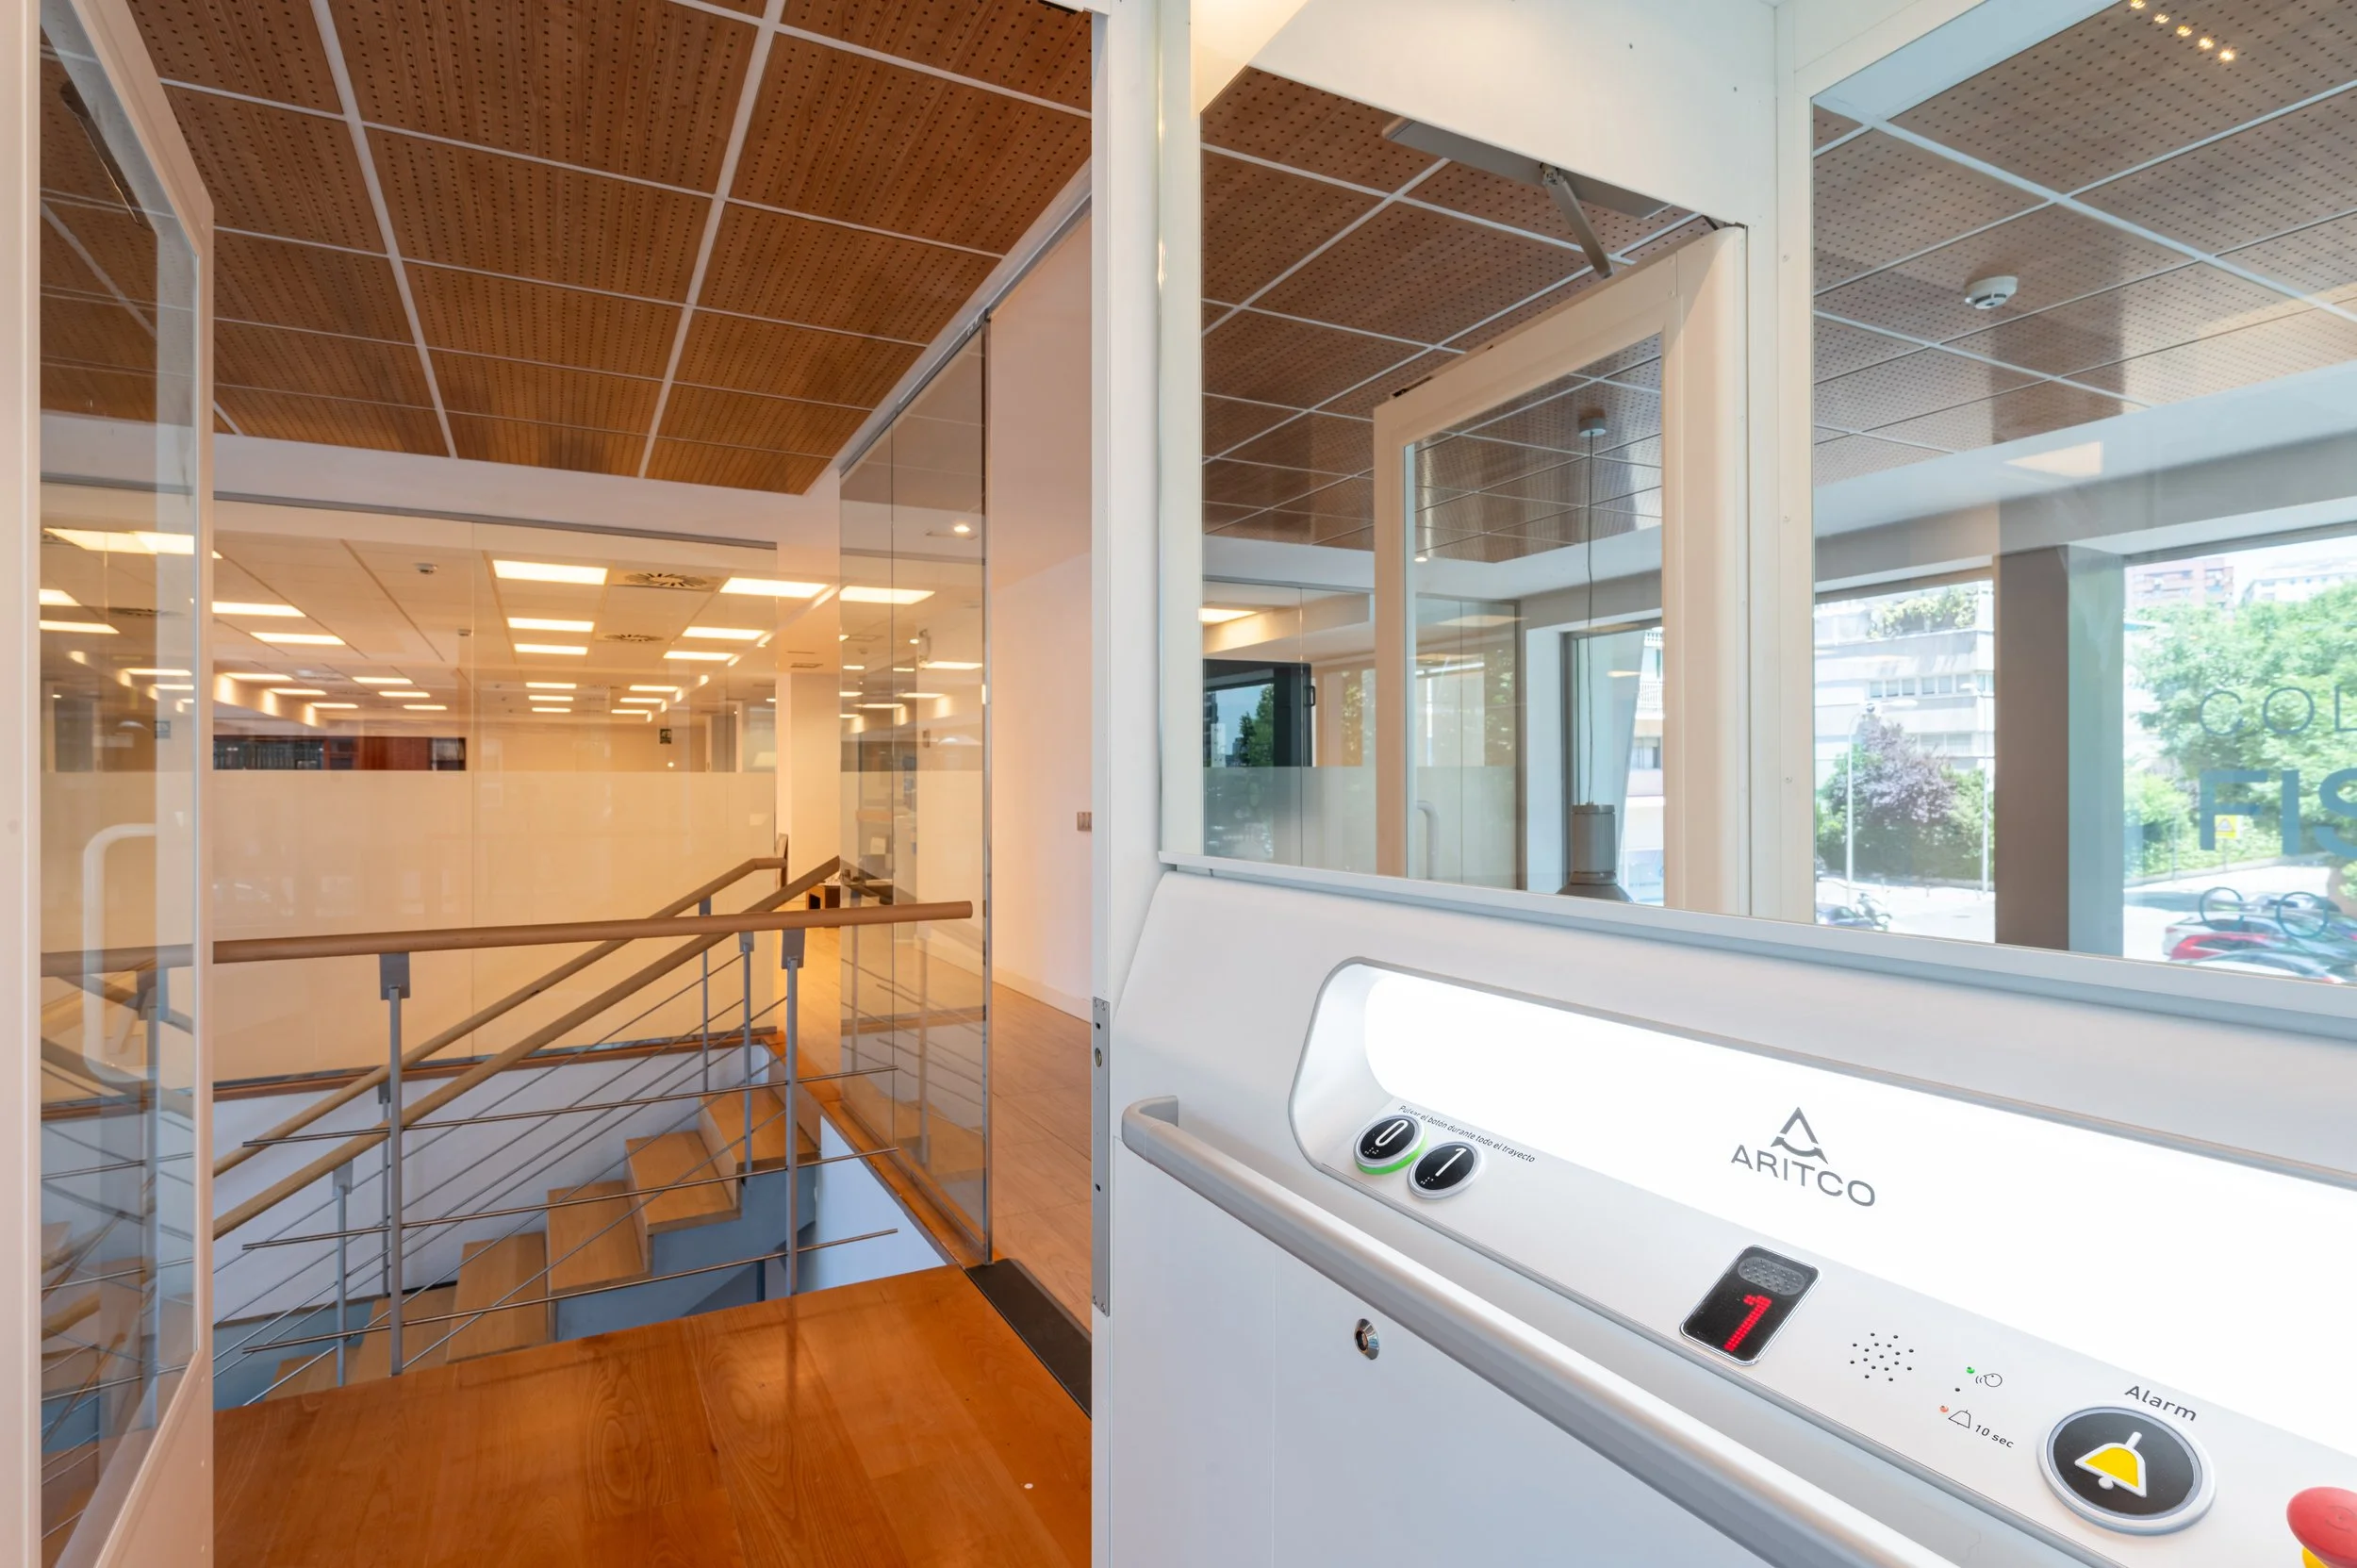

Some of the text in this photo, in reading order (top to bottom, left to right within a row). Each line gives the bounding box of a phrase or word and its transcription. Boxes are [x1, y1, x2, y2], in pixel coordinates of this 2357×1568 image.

[1376, 1119, 1408, 1147] 0
[1447, 1125, 1476, 1140] durante
[1475, 1134, 1493, 1147] todo
[1493, 1142, 1504, 1150] el
[1502, 1145, 1536, 1163] trayecto
[1435, 1147, 1466, 1177] 1
[1731, 1144, 1876, 1207] ARITCO
[1723, 1295, 1772, 1352] 1
[2124, 1385, 2197, 1422] Alarm
[1975, 1425, 2014, 1448] 10 sec
